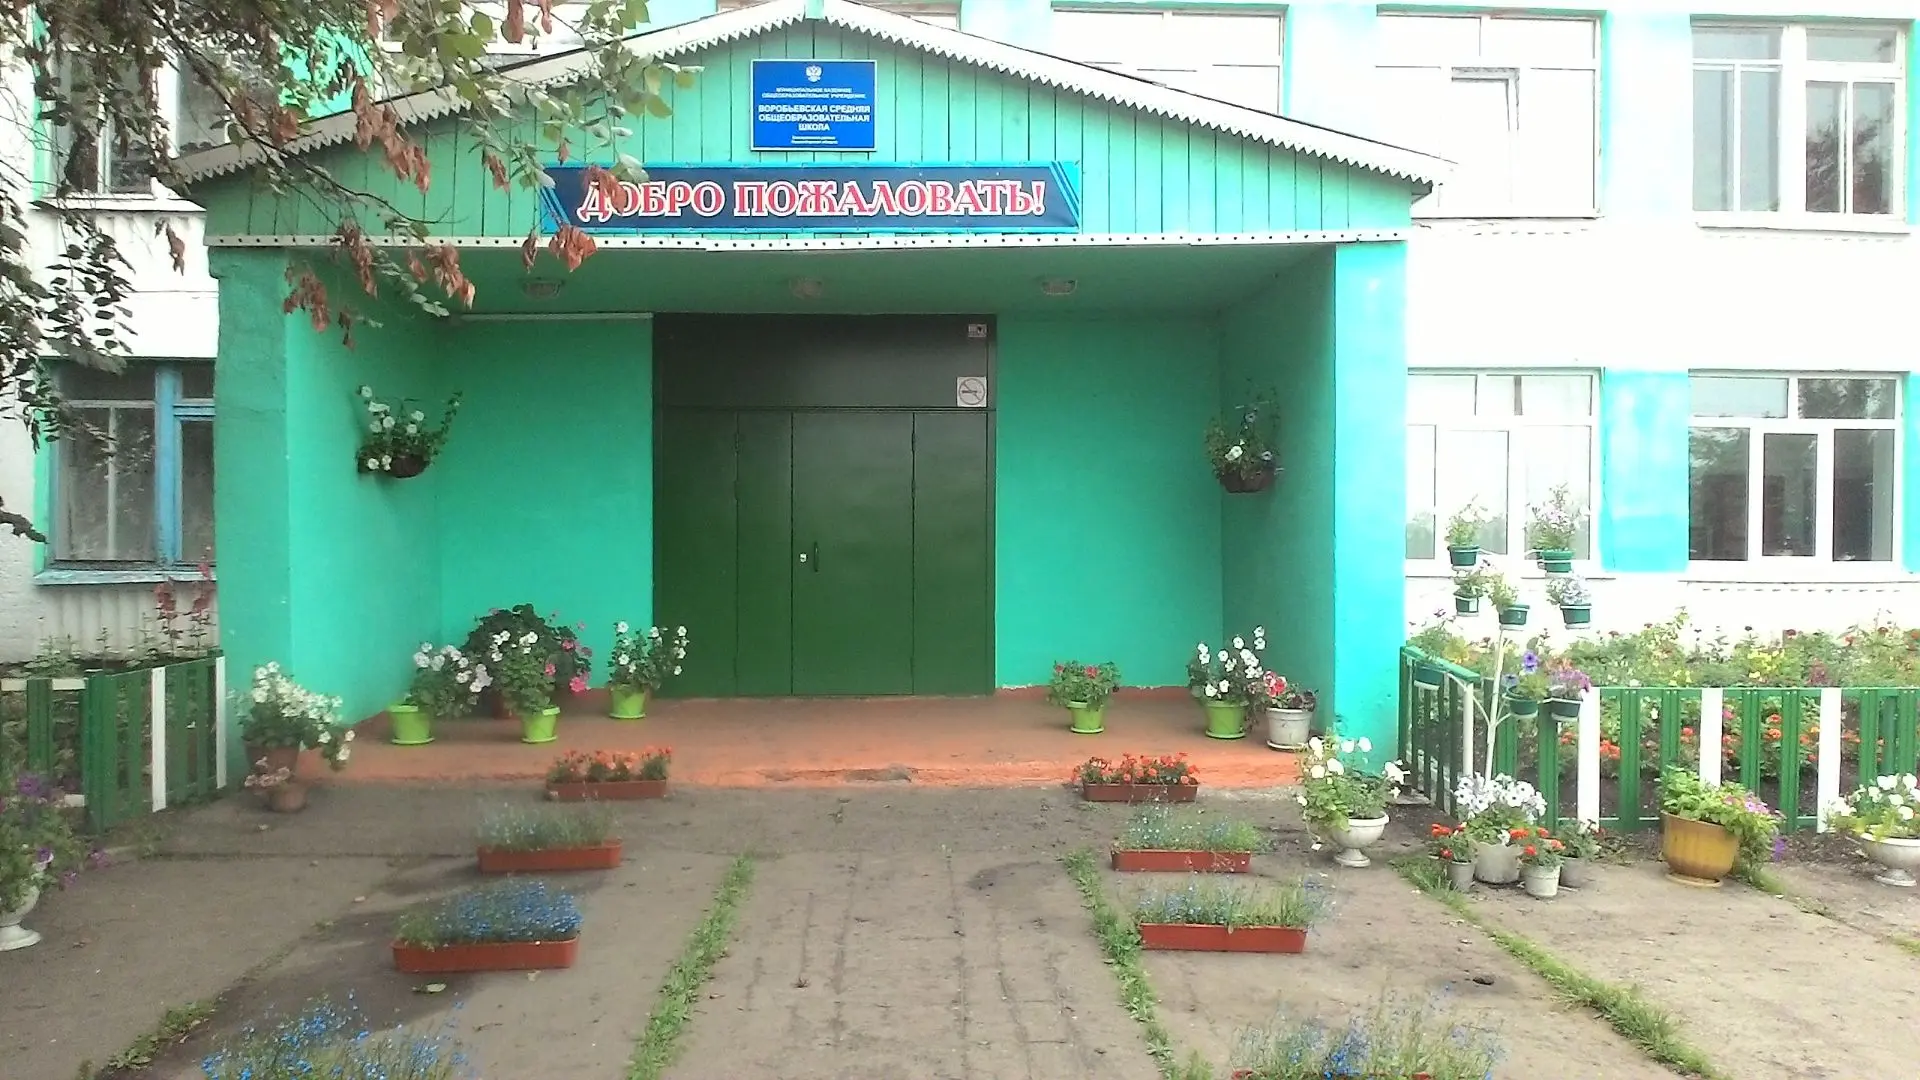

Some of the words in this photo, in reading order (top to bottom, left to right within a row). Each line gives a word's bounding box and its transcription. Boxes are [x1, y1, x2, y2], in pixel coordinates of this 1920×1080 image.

[758, 105, 828, 113] ВОРОБЬЕВСКАЯ
[829, 105, 871, 113] СРЕДНЯЯ
[758, 114, 870, 122] ОБЩЕОБРАЗОВАТЕЛЬНАЯ
[798, 123, 830, 131] ШКОЛА
[576, 180, 726, 223] ДОБРО
[733, 180, 1046, 217] ПОЖАЛОВАТЬ!
